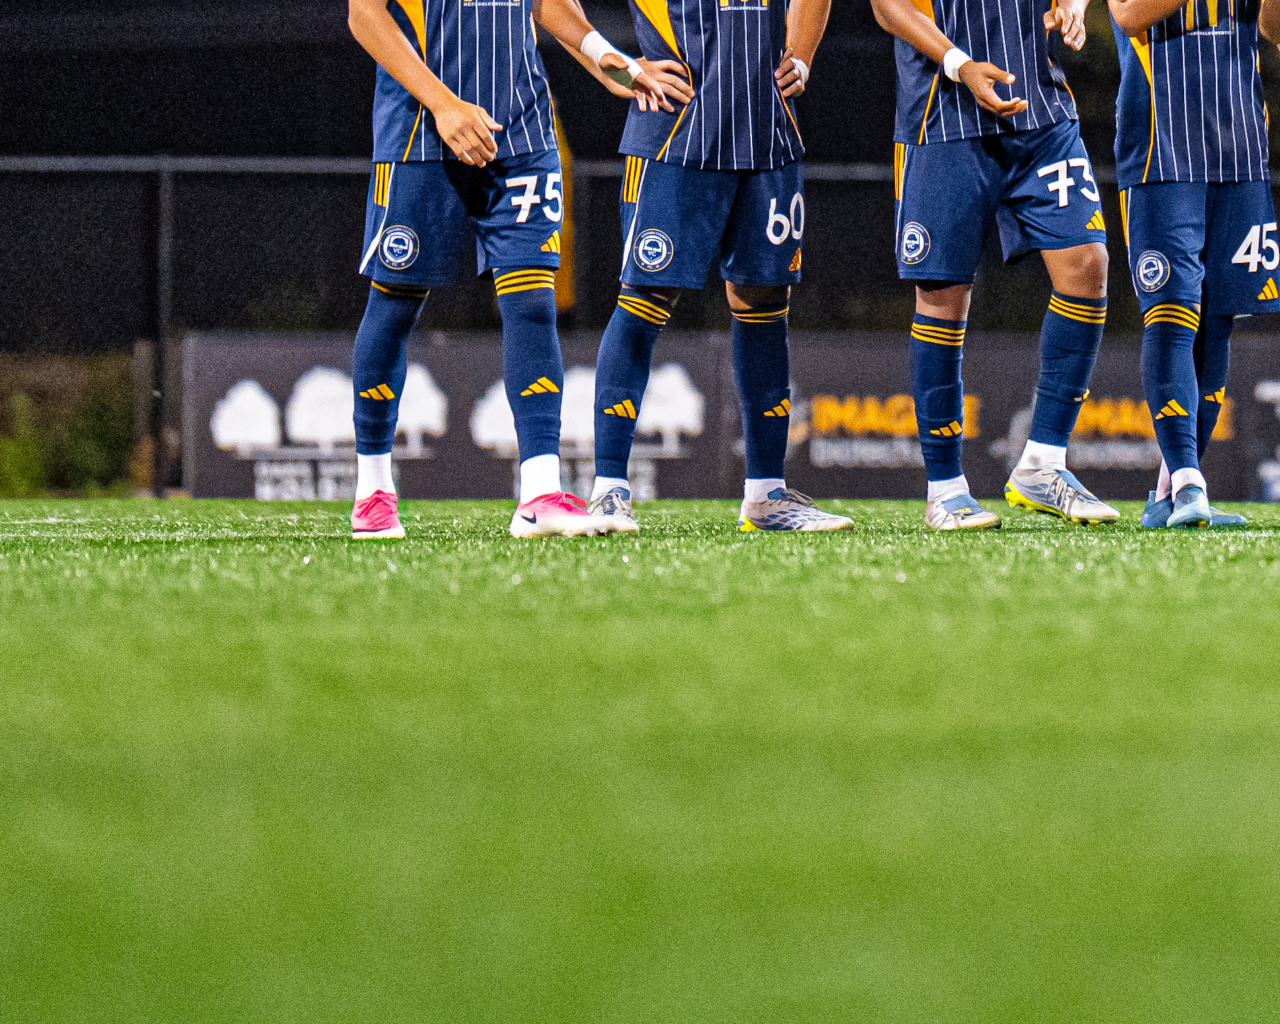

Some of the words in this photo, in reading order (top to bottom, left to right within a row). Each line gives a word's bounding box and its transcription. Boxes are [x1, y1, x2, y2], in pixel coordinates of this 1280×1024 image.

[505, 173, 562, 223] 75
[1037, 158, 1100, 207] 73
[766, 192, 805, 245] 60
[1232, 222, 1280, 273] 45
